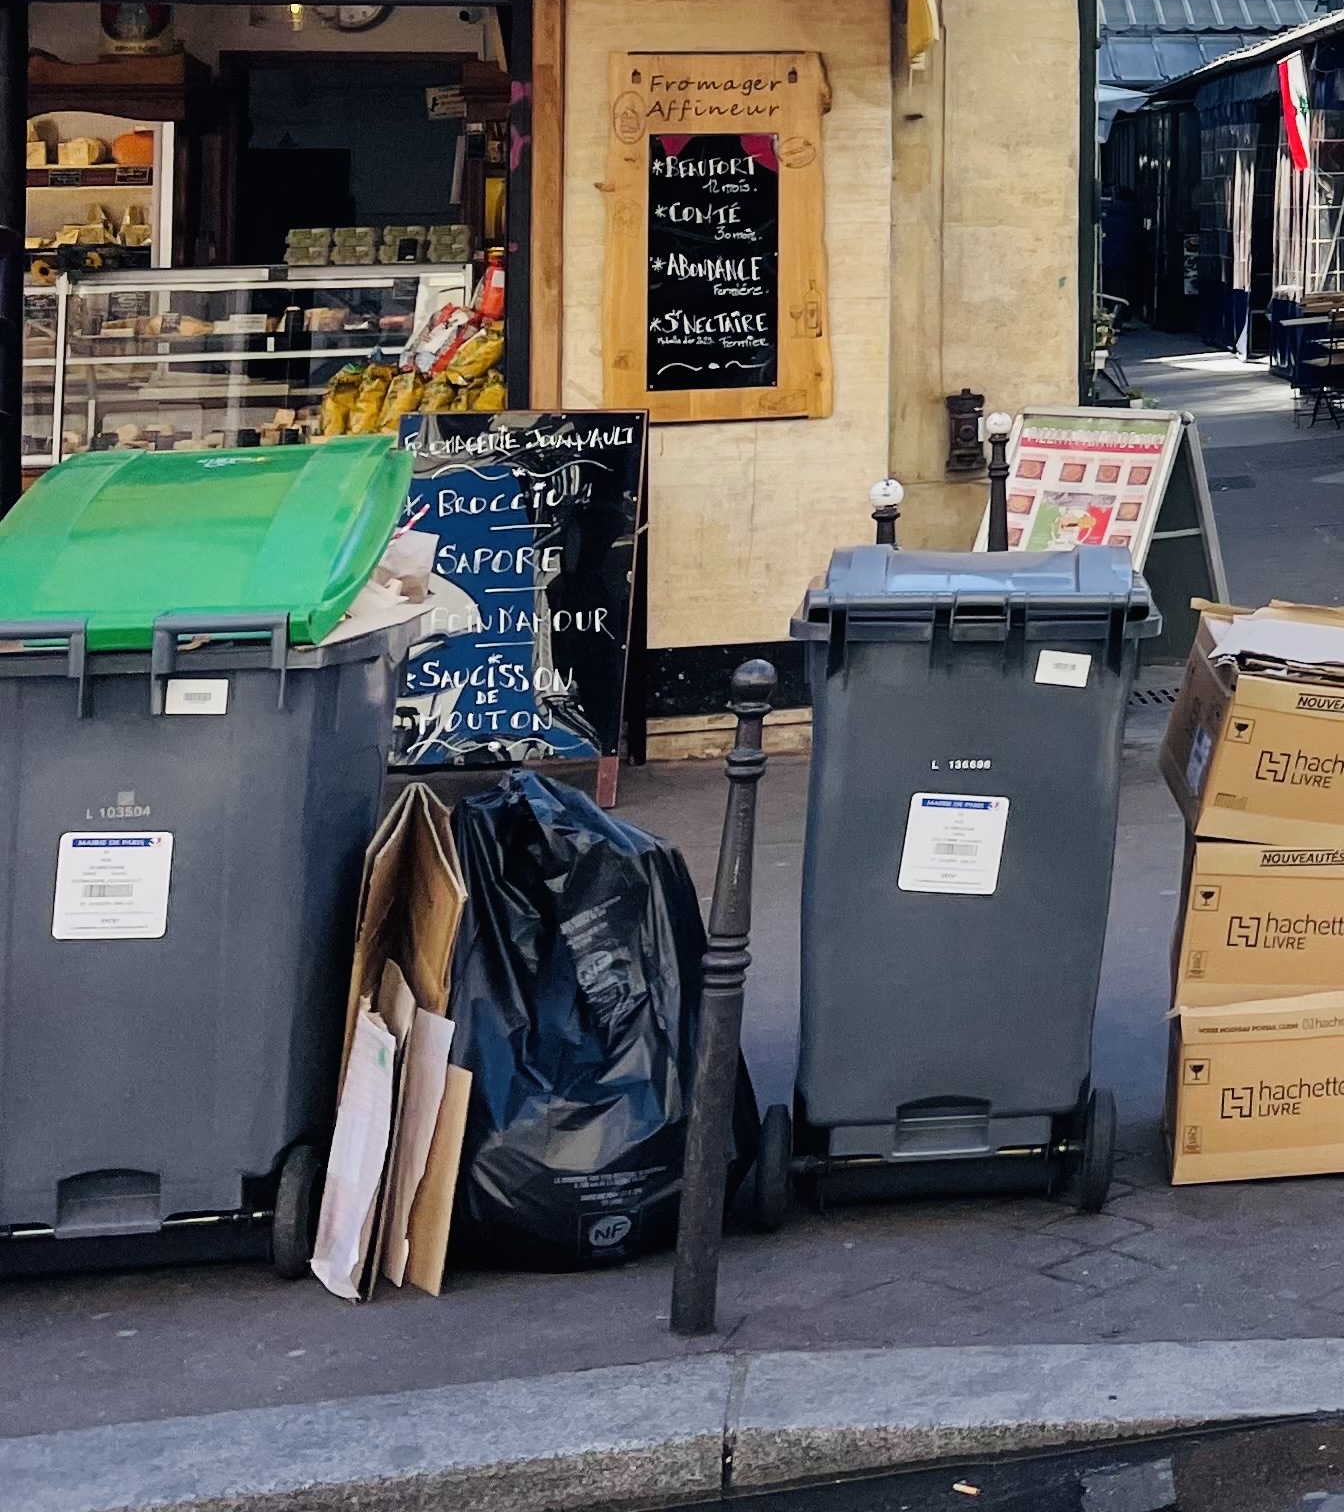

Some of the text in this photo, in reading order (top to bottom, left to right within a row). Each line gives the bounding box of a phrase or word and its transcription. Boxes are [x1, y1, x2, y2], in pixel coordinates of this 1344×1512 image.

[650, 74, 782, 97] Fromager
[646, 99, 780, 122] Affineur
[665, 154, 763, 178] BEAUFORT
[436, 543, 564, 576] SAPORE
[419, 653, 574, 692] SAUCISSON
[475, 688, 500, 705] DE
[418, 707, 554, 735] MOUTON
[931, 759, 940, 770] L
[1290, 772, 1333, 789] LIVRE
[1262, 936, 1306, 951] LIVRE
[1258, 1101, 1302, 1118] LIVRE
